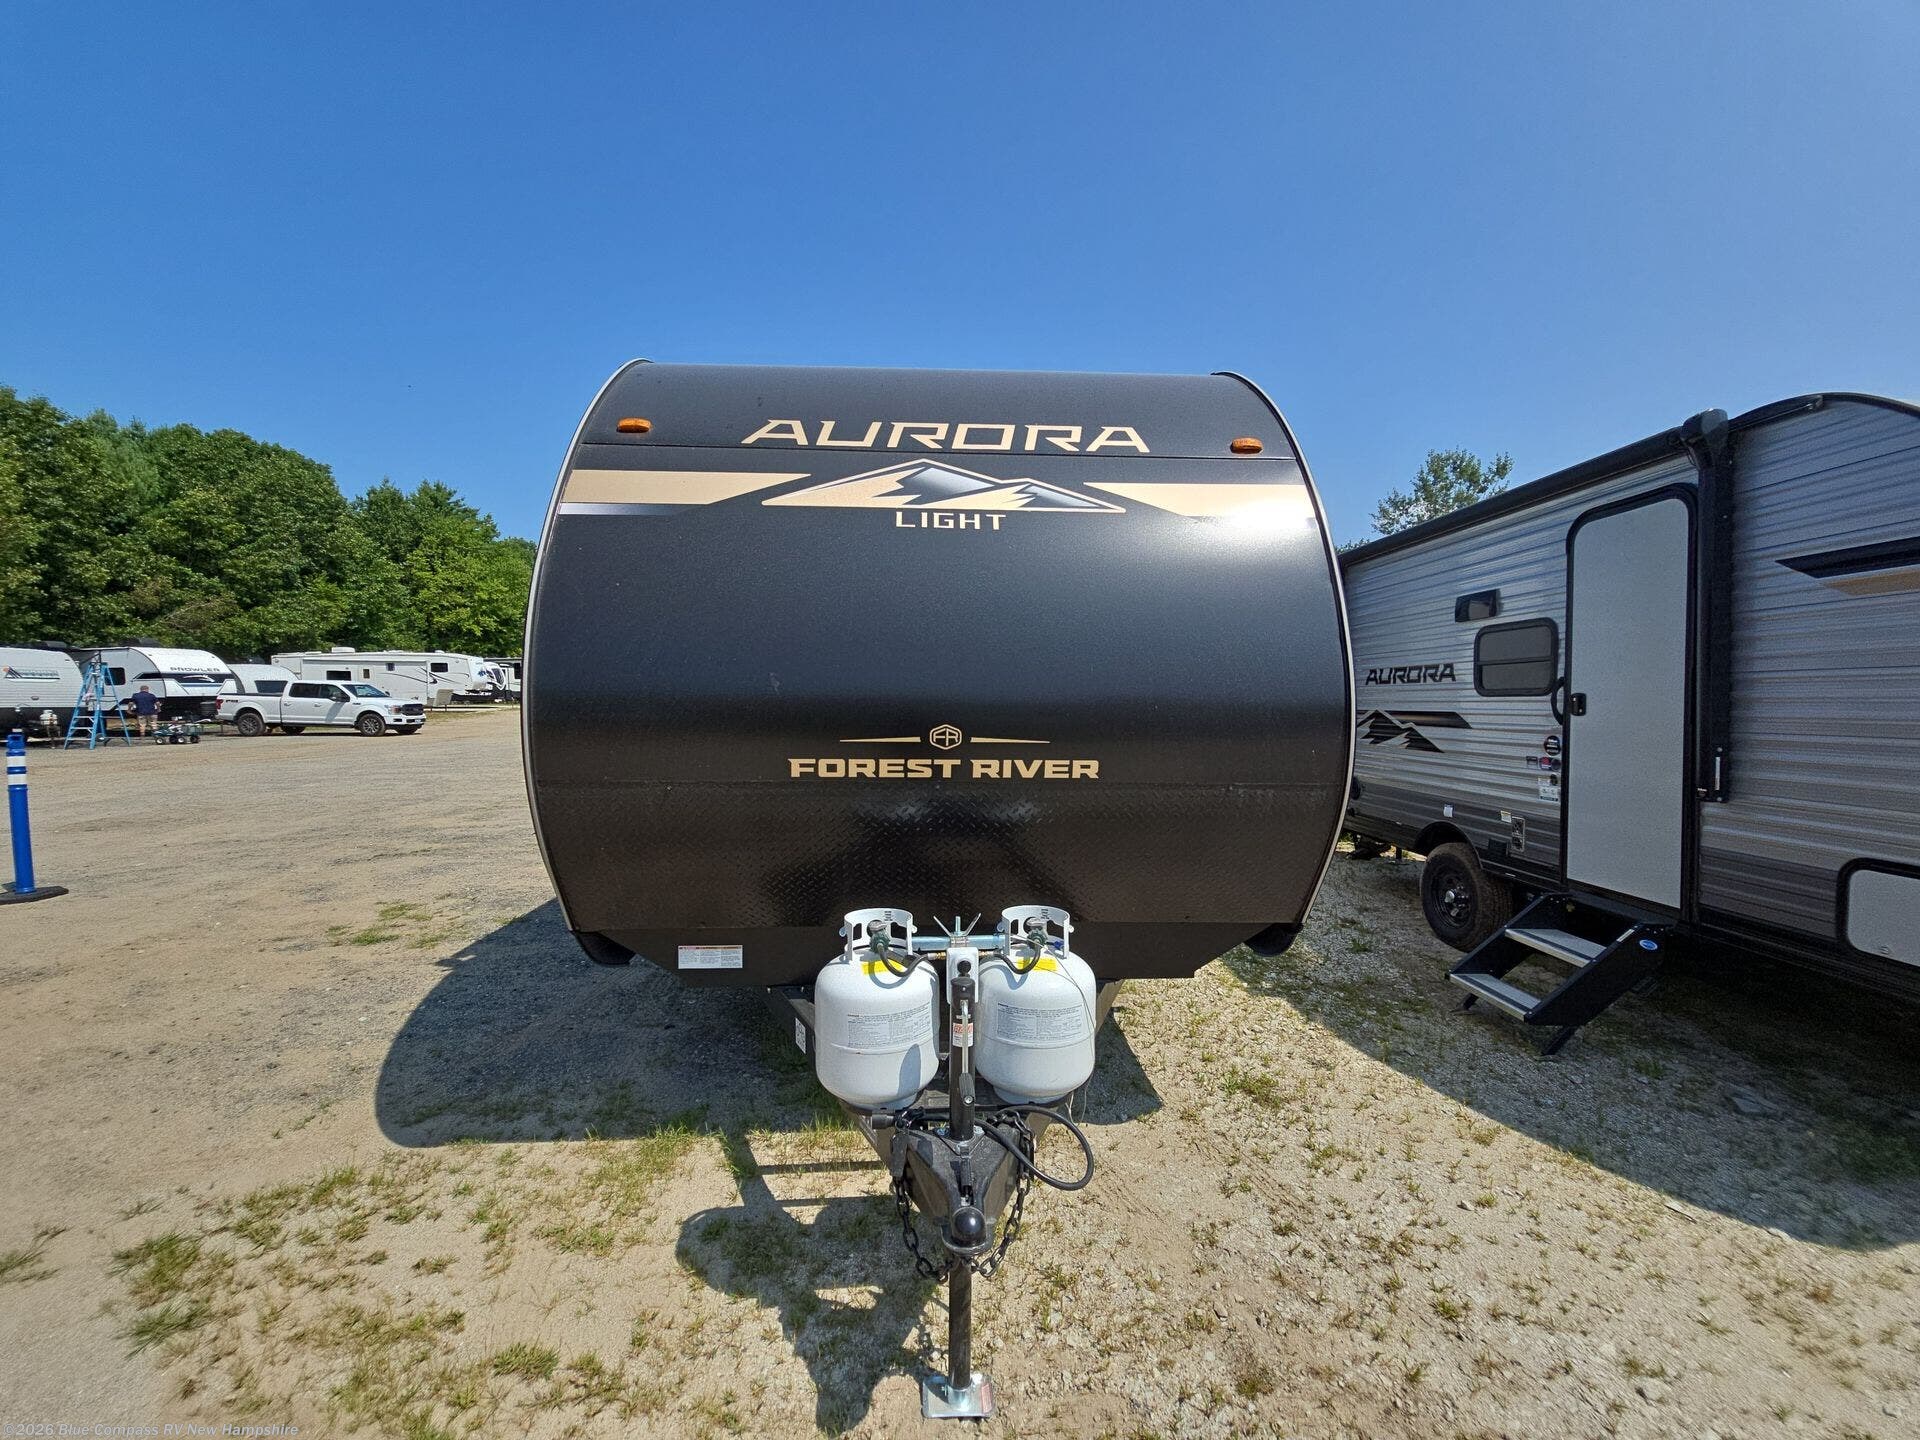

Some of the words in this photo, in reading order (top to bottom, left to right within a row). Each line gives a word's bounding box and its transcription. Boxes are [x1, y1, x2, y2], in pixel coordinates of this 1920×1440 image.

[741, 419, 1150, 453] AURORA
[895, 511, 1006, 531] LIGHT
[1365, 663, 1457, 685] AURORA
[788, 758, 961, 778] FOREST
[970, 759, 1100, 779] RIVER
